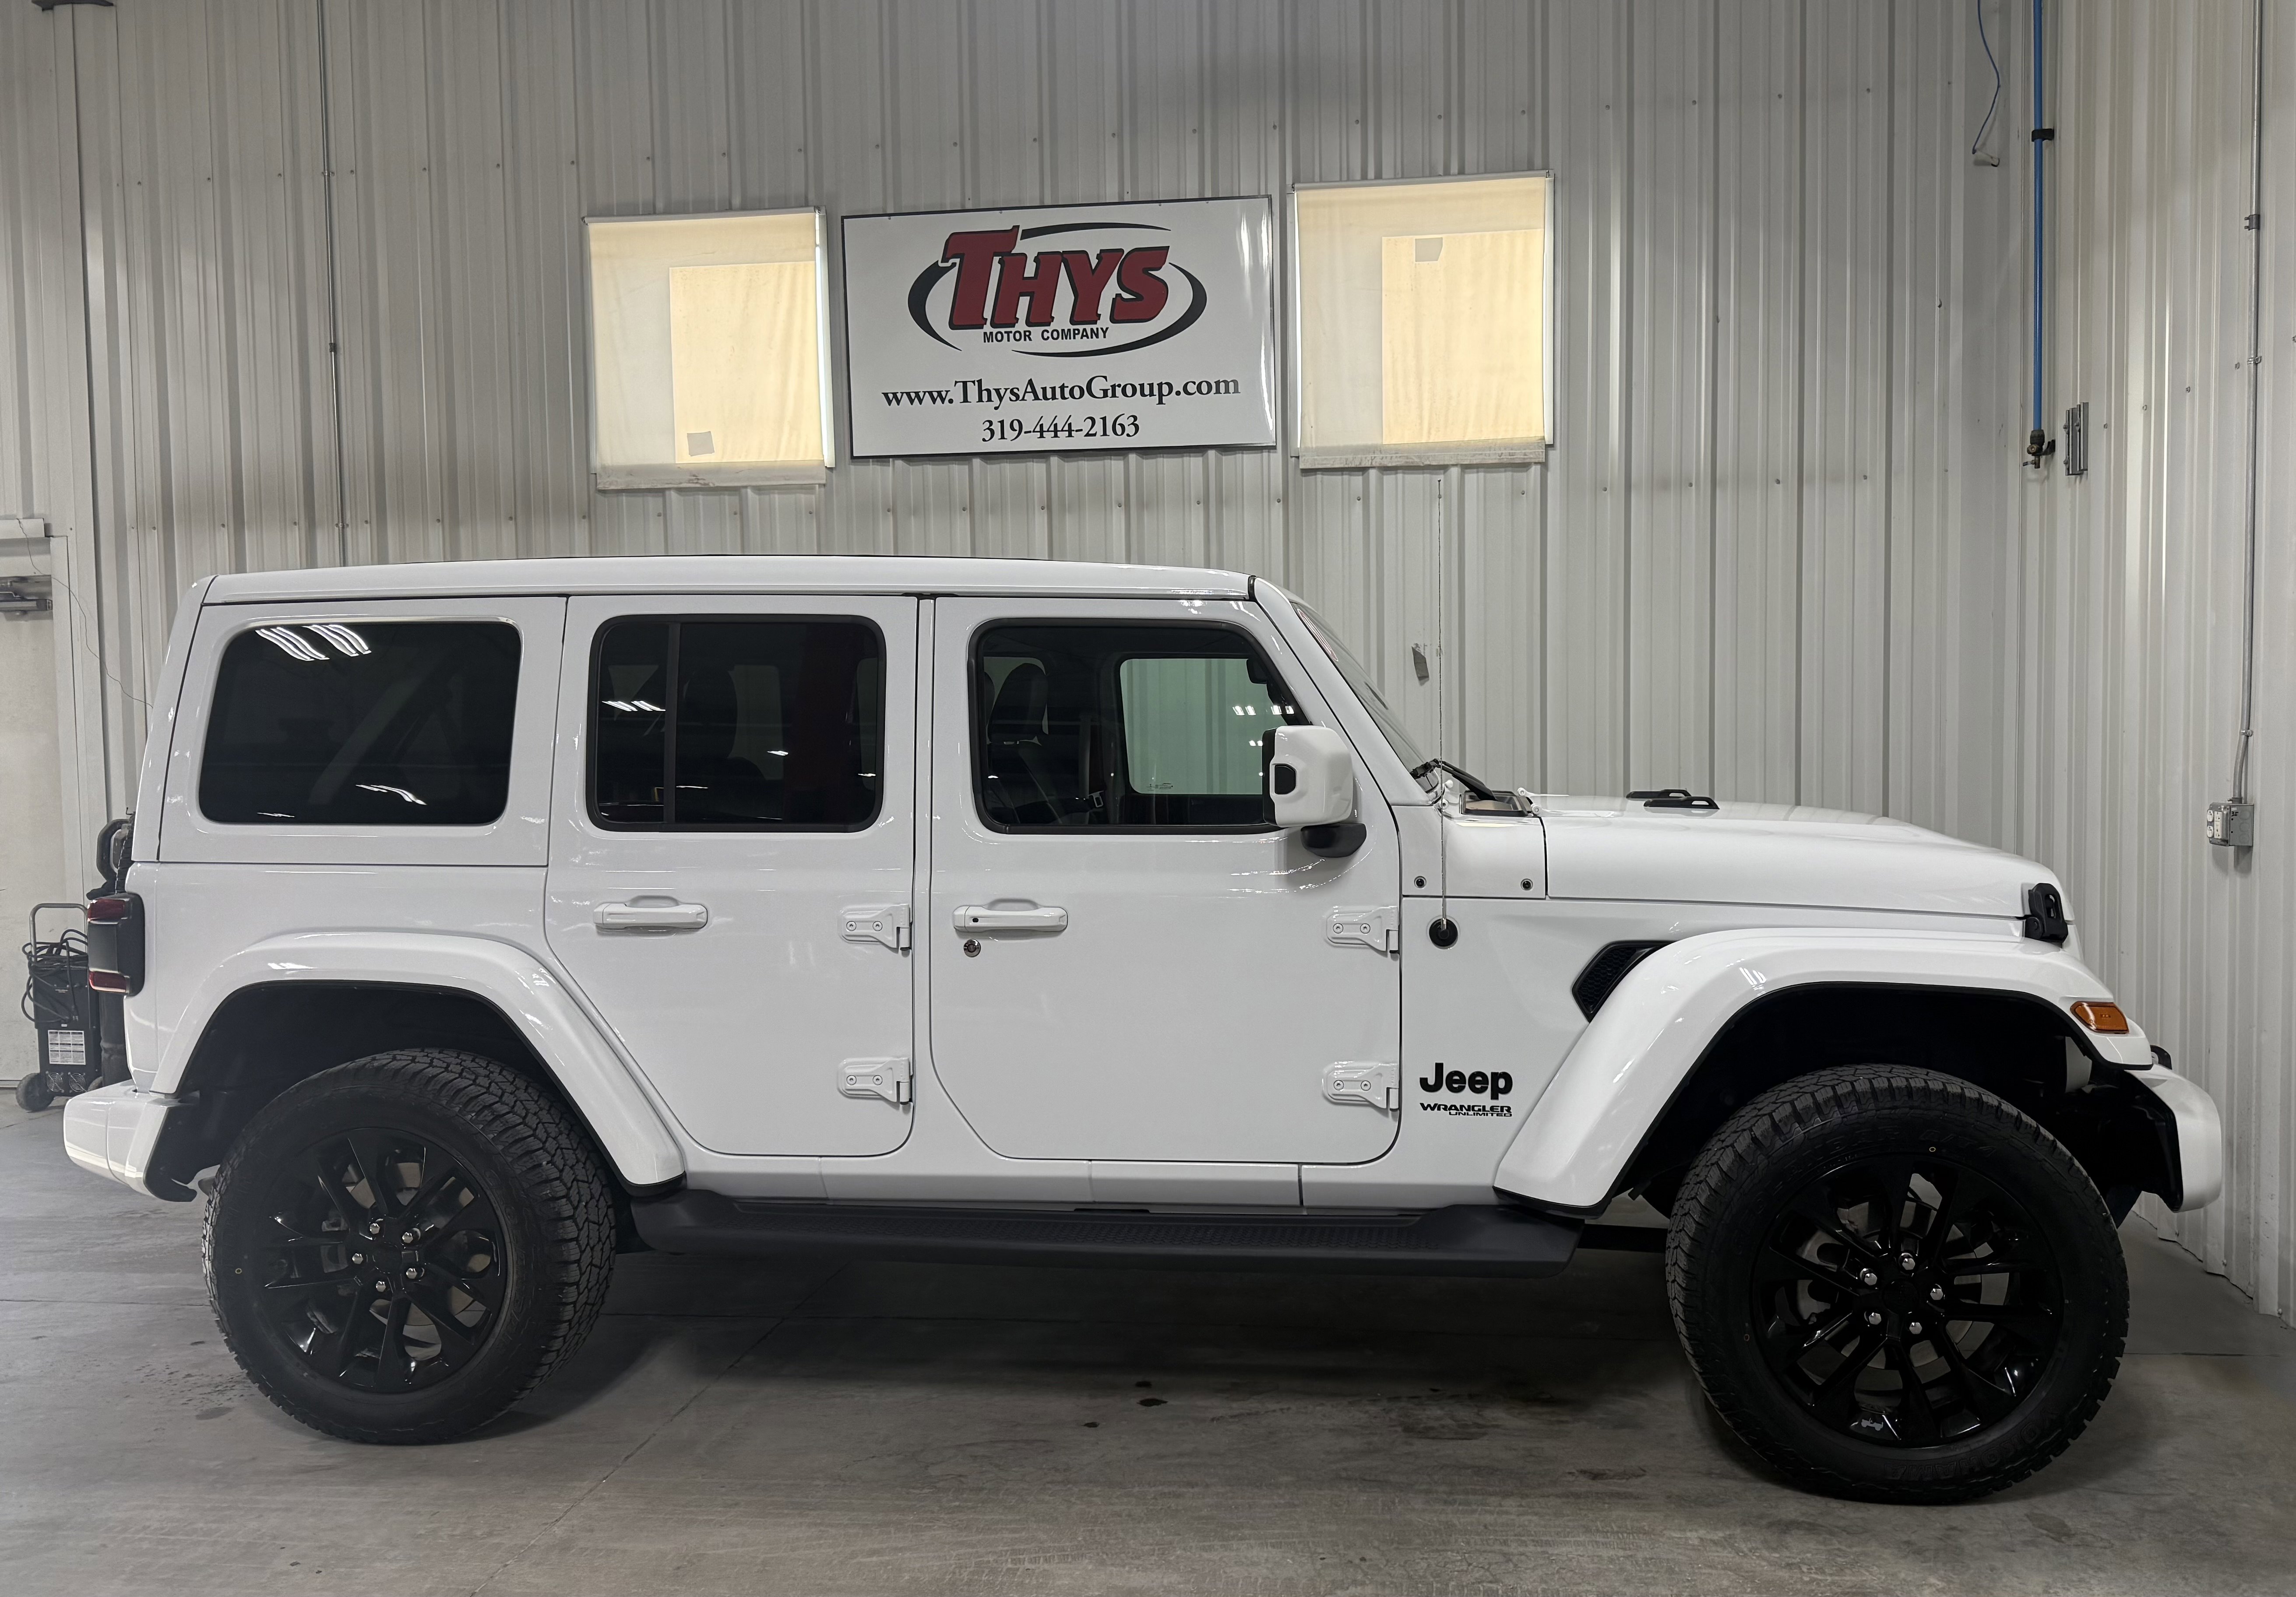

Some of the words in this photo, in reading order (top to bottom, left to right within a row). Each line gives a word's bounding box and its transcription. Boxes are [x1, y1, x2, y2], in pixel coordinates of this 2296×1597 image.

[940, 225, 1170, 330] THYS
[982, 329, 1032, 343] MOTOR
[1041, 327, 1109, 341] COMPANY
[881, 375, 1241, 410] www.ThysAutoGroup.com
[982, 413, 1139, 442] 319-444-2163
[1419, 1062, 1513, 1100] Jeep
[1419, 1103, 1512, 1113] WRANGLER
